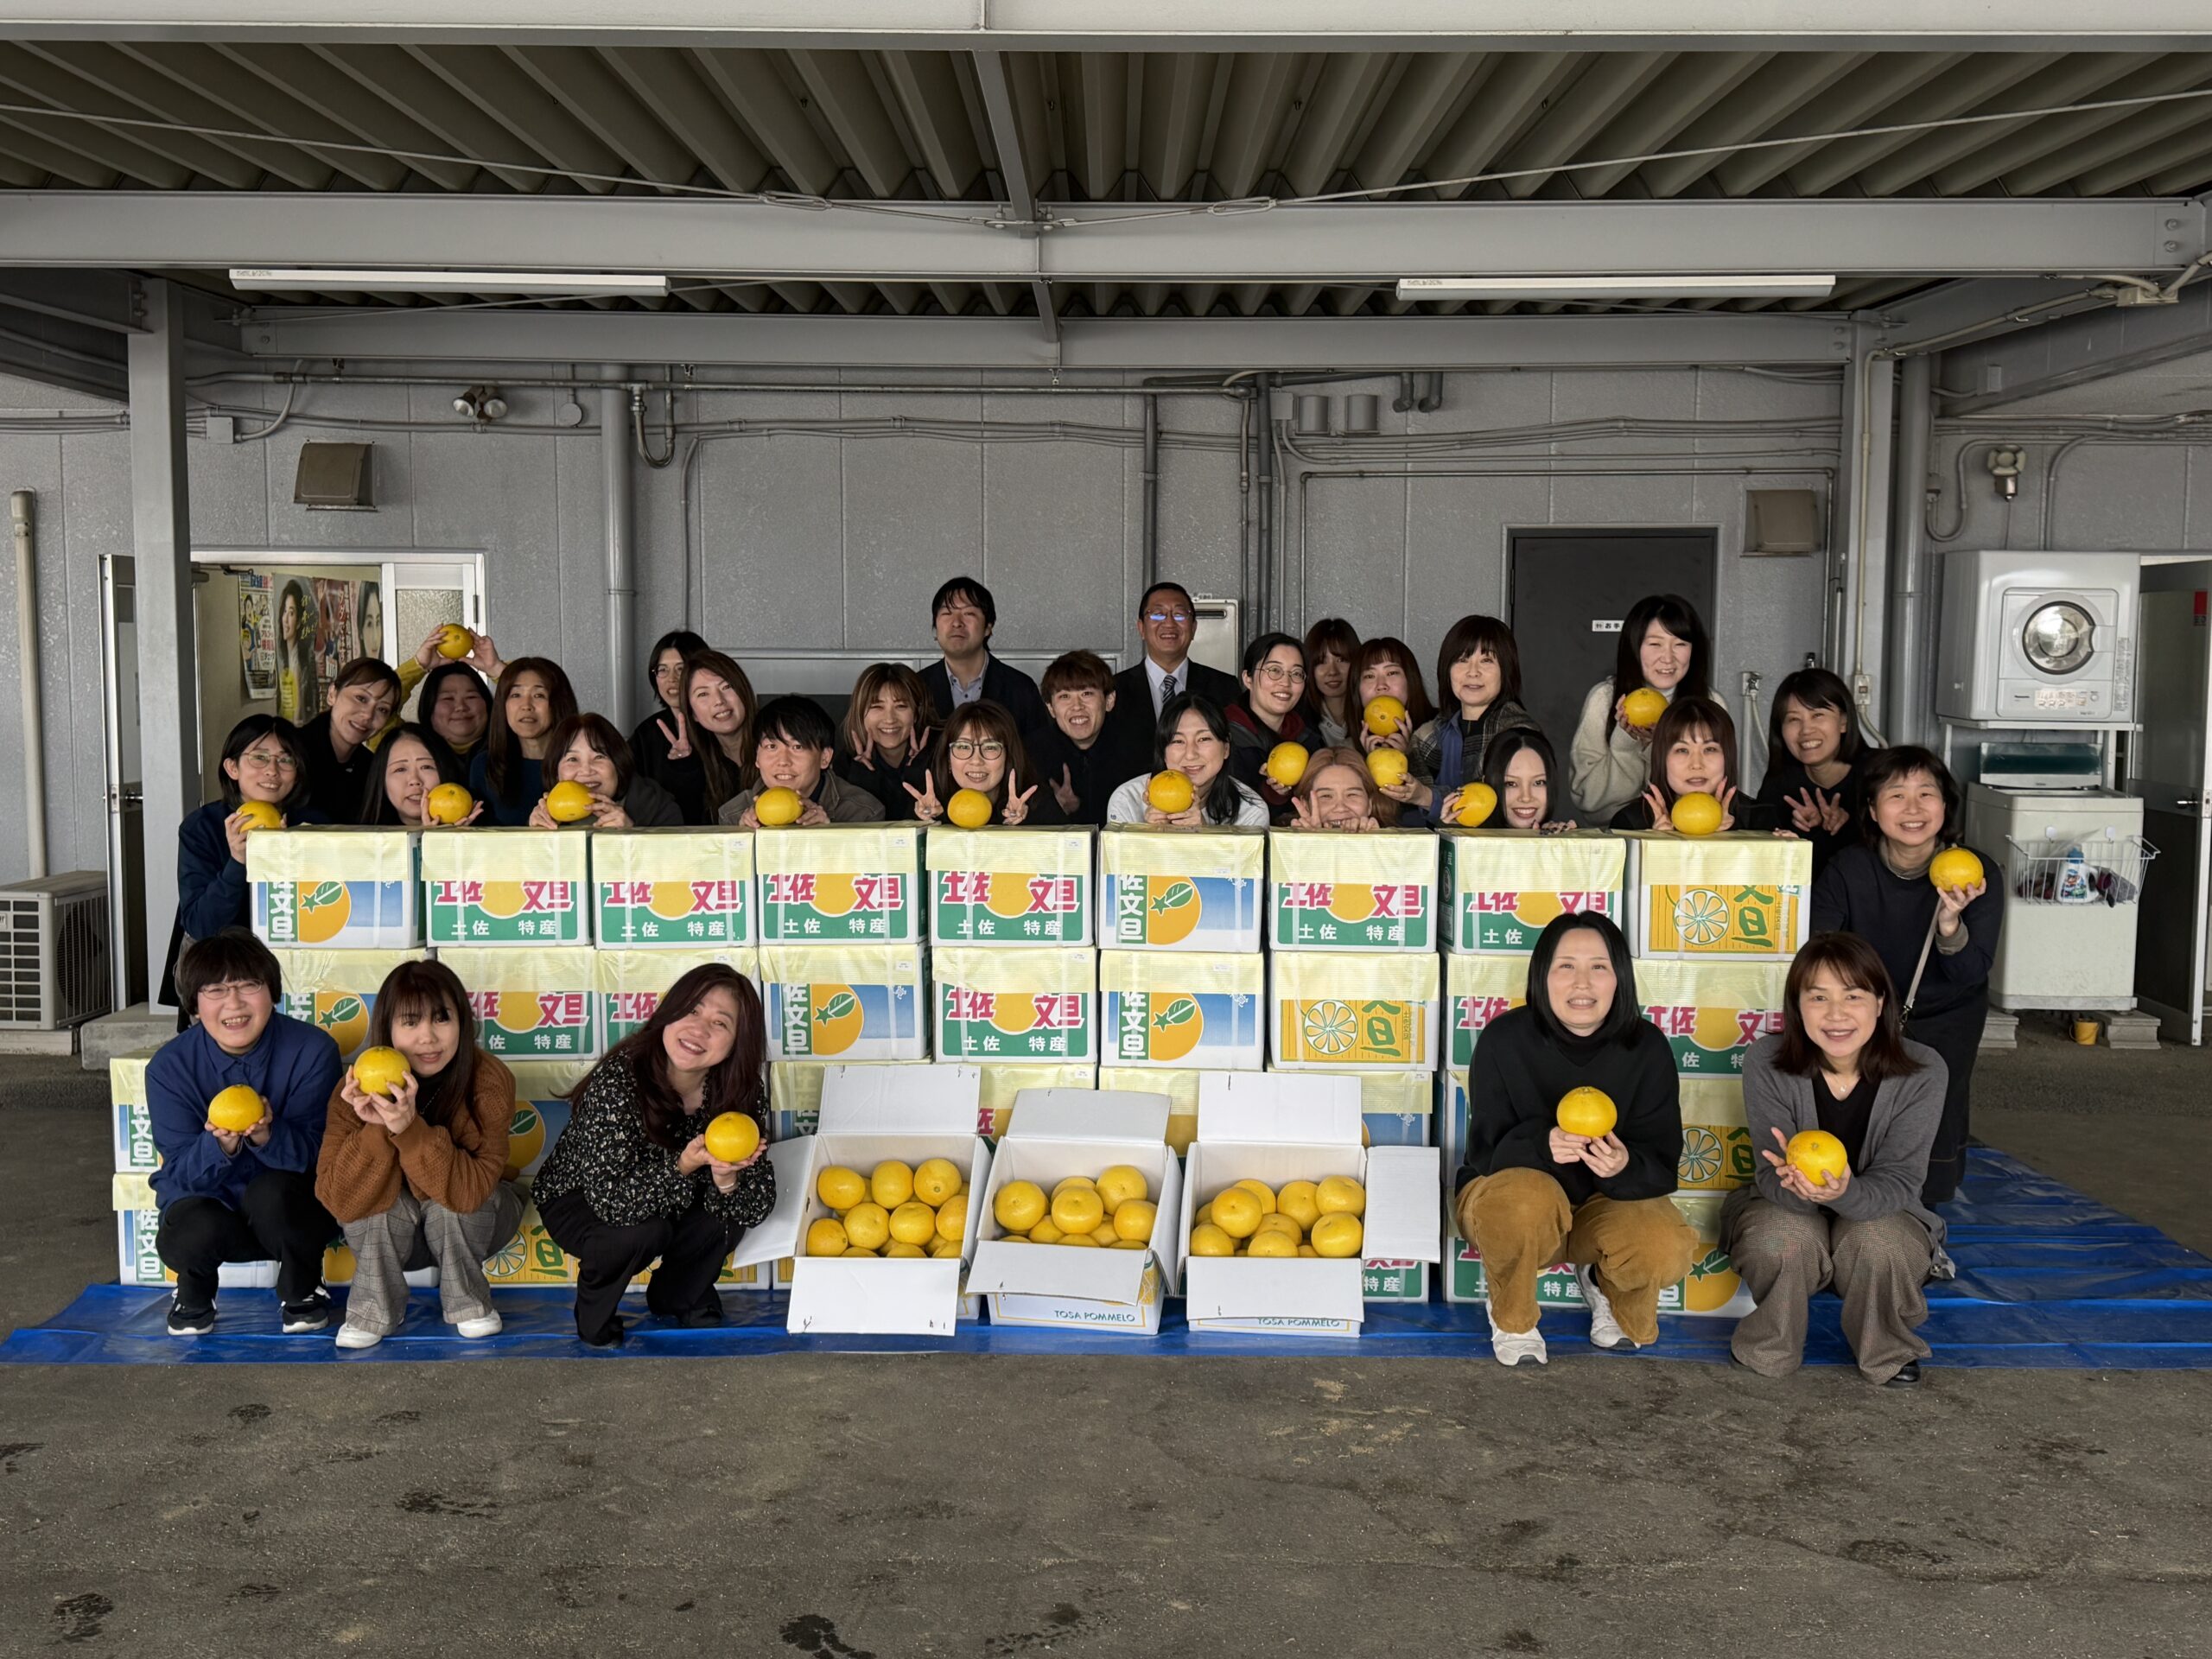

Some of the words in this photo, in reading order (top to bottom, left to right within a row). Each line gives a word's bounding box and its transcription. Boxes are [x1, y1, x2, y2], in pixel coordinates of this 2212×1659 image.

[522, 881, 571, 910] 文旦
[691, 880, 740, 912] 文旦
[769, 874, 816, 902] 土佐
[853, 877, 901, 910] 文旦
[944, 871, 989, 903] 土佐
[1028, 880, 1077, 912] 文旦
[1371, 885, 1421, 916] 文旦
[451, 920, 490, 936] 土佐
[518, 919, 556, 936] 特産
[621, 922, 659, 938] 土佐
[687, 921, 726, 937] 特産
[784, 918, 821, 934] 土佐
[849, 918, 886, 934] 特産
[957, 919, 995, 935] 土佐
[1024, 919, 1061, 936] 特産
[1298, 924, 1337, 940] 土佐
[1366, 925, 1405, 941] 特産
[1483, 928, 1522, 944] 土佐
[537, 994, 588, 1026] 文旦
[948, 987, 995, 1020] 土佐
[1033, 995, 1081, 1027] 文旦
[534, 1034, 572, 1050] 特産
[963, 1036, 1001, 1052] 土佐
[1028, 1036, 1066, 1052] 特産
[1364, 1276, 1401, 1293] 特産
[1543, 1281, 1583, 1298] 特産
[1054, 1310, 1081, 1319] TOSA
[1084, 1312, 1135, 1322] POMMELO
[1287, 1319, 1339, 1327] POMMELO
